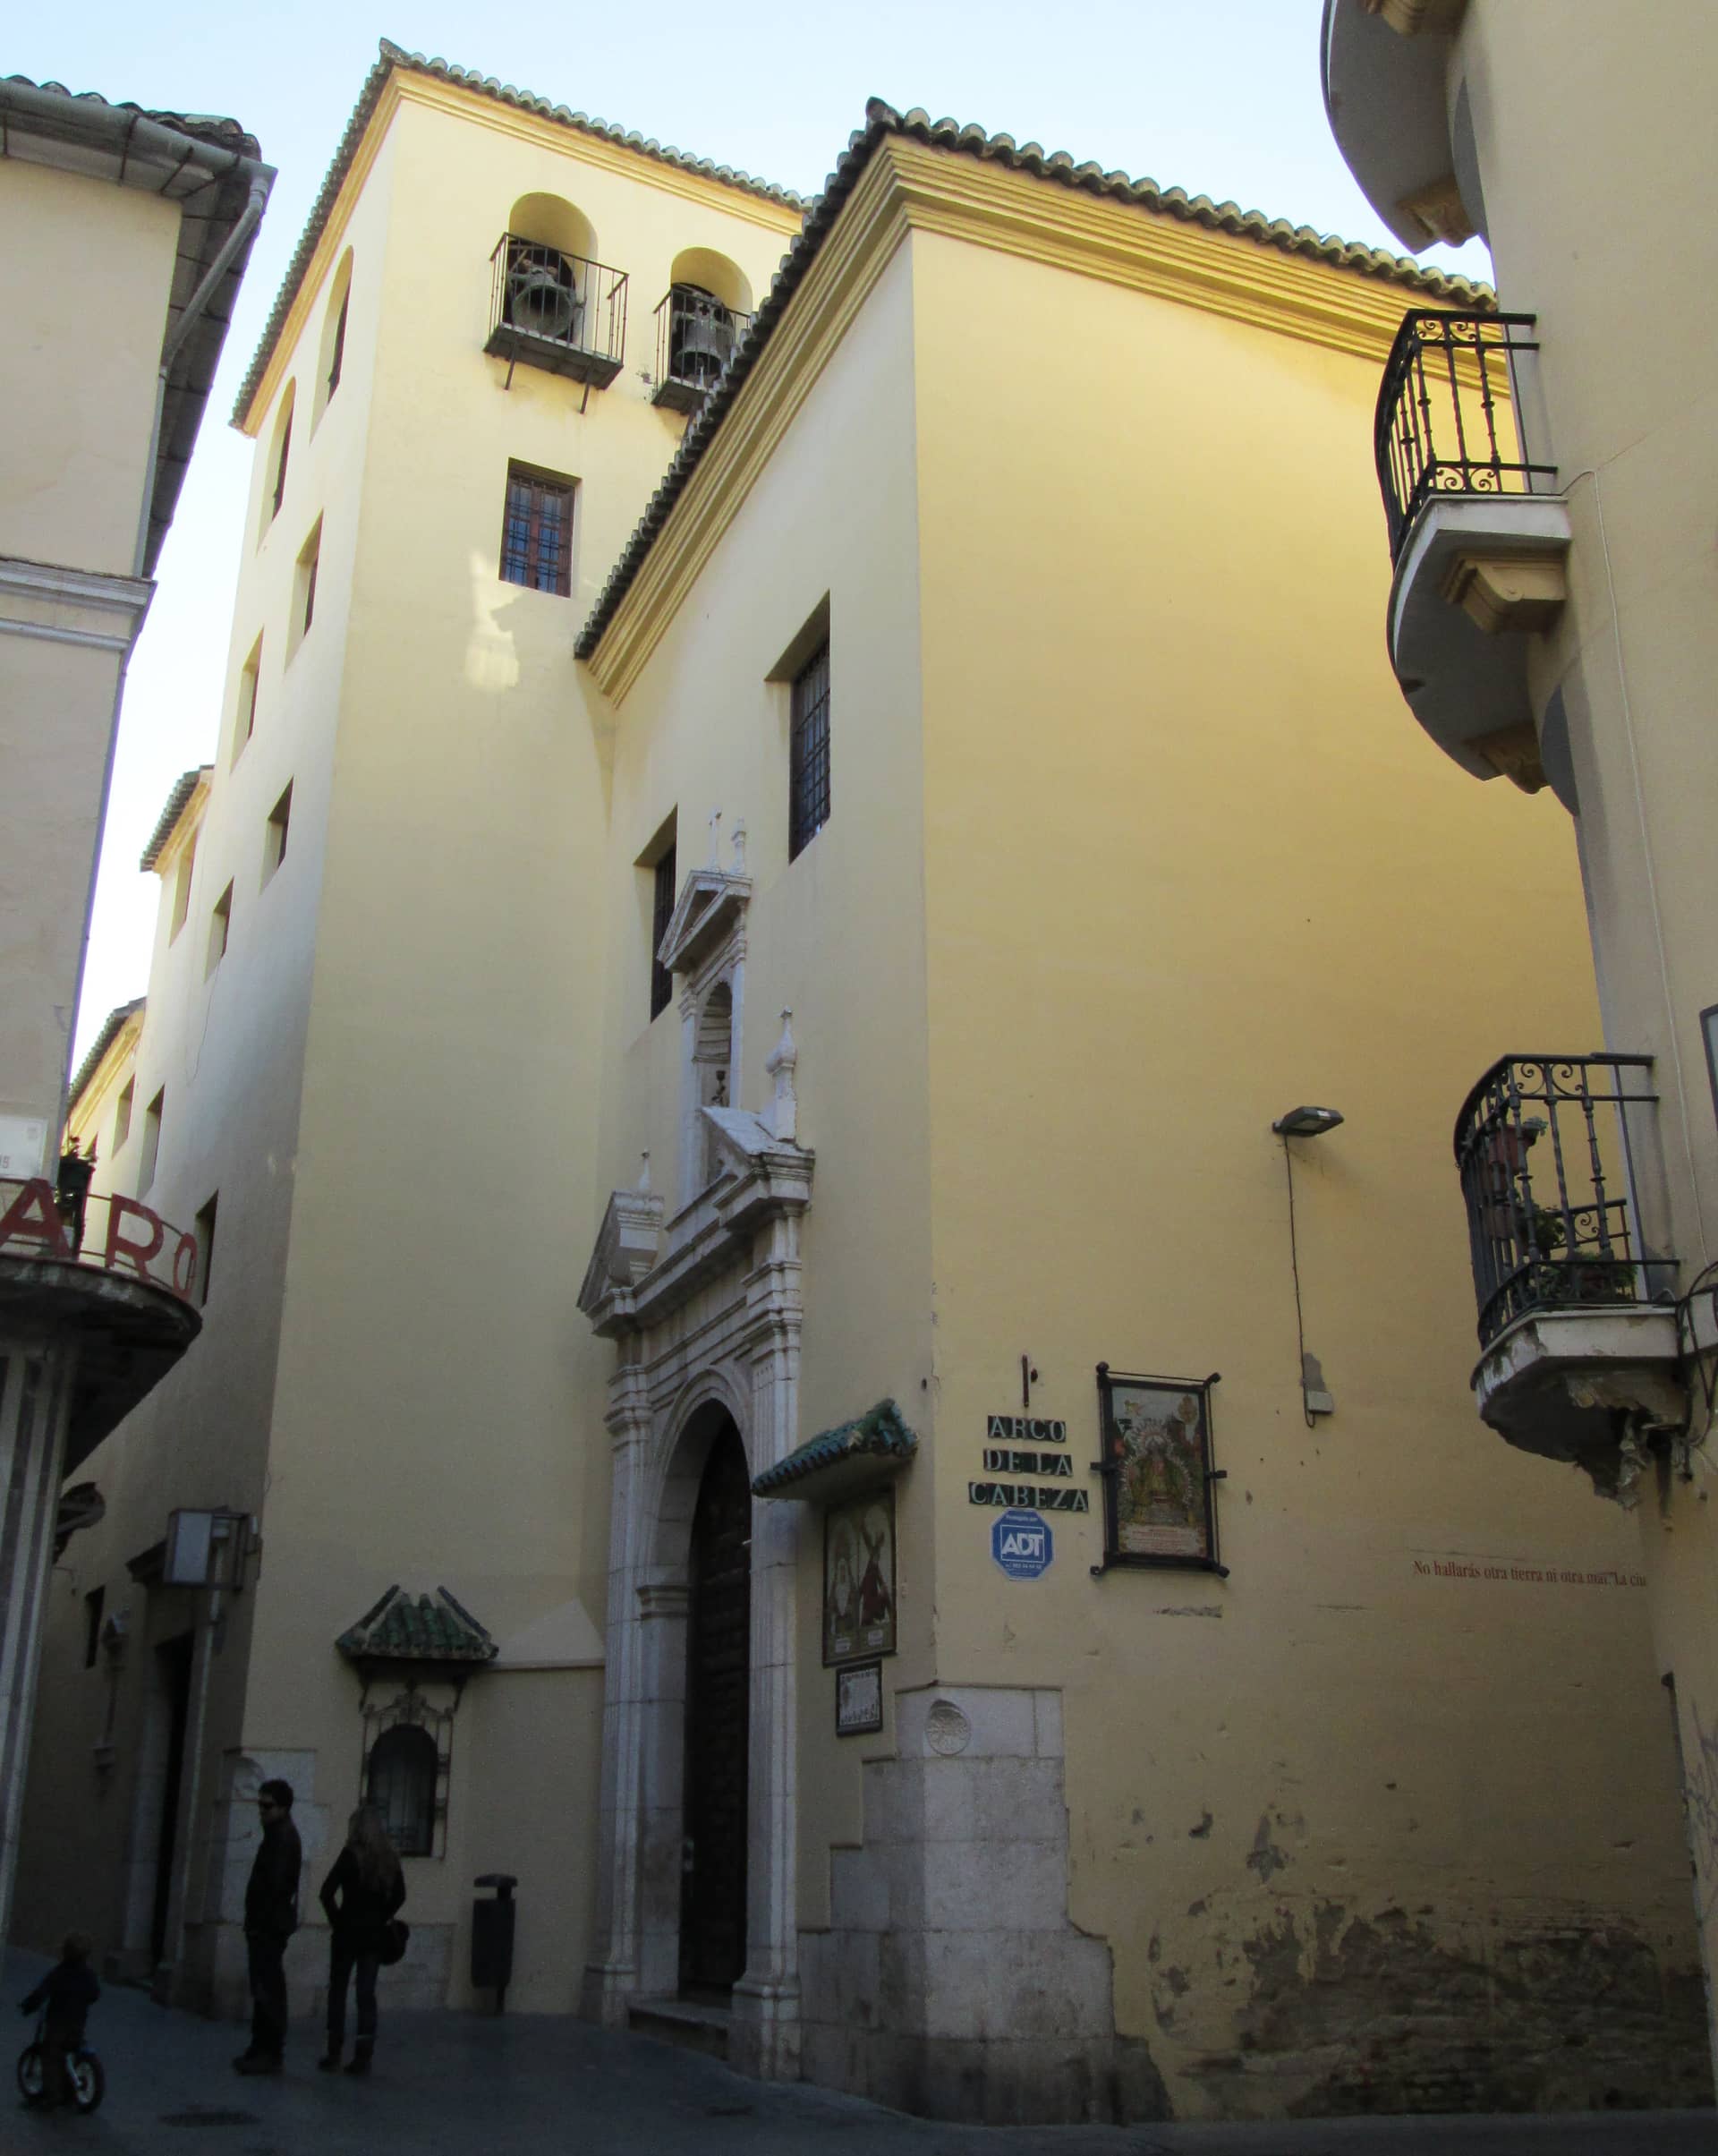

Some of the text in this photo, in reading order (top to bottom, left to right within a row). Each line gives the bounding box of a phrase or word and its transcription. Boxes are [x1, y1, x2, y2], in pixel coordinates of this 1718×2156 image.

[989, 1416, 1066, 1442] ARCO
[985, 1449, 1073, 1477] DE LA
[970, 1482, 1089, 1512] CABEZA
[1001, 1532, 1044, 1556] ADT
[1413, 1560, 1430, 1575] No
[1433, 1560, 1481, 1578] hallarás
[1484, 1566, 1508, 1580] otra
[1510, 1566, 1543, 1582] tierra
[1546, 1568, 1557, 1583] ni
[1561, 1571, 1583, 1584] otra
